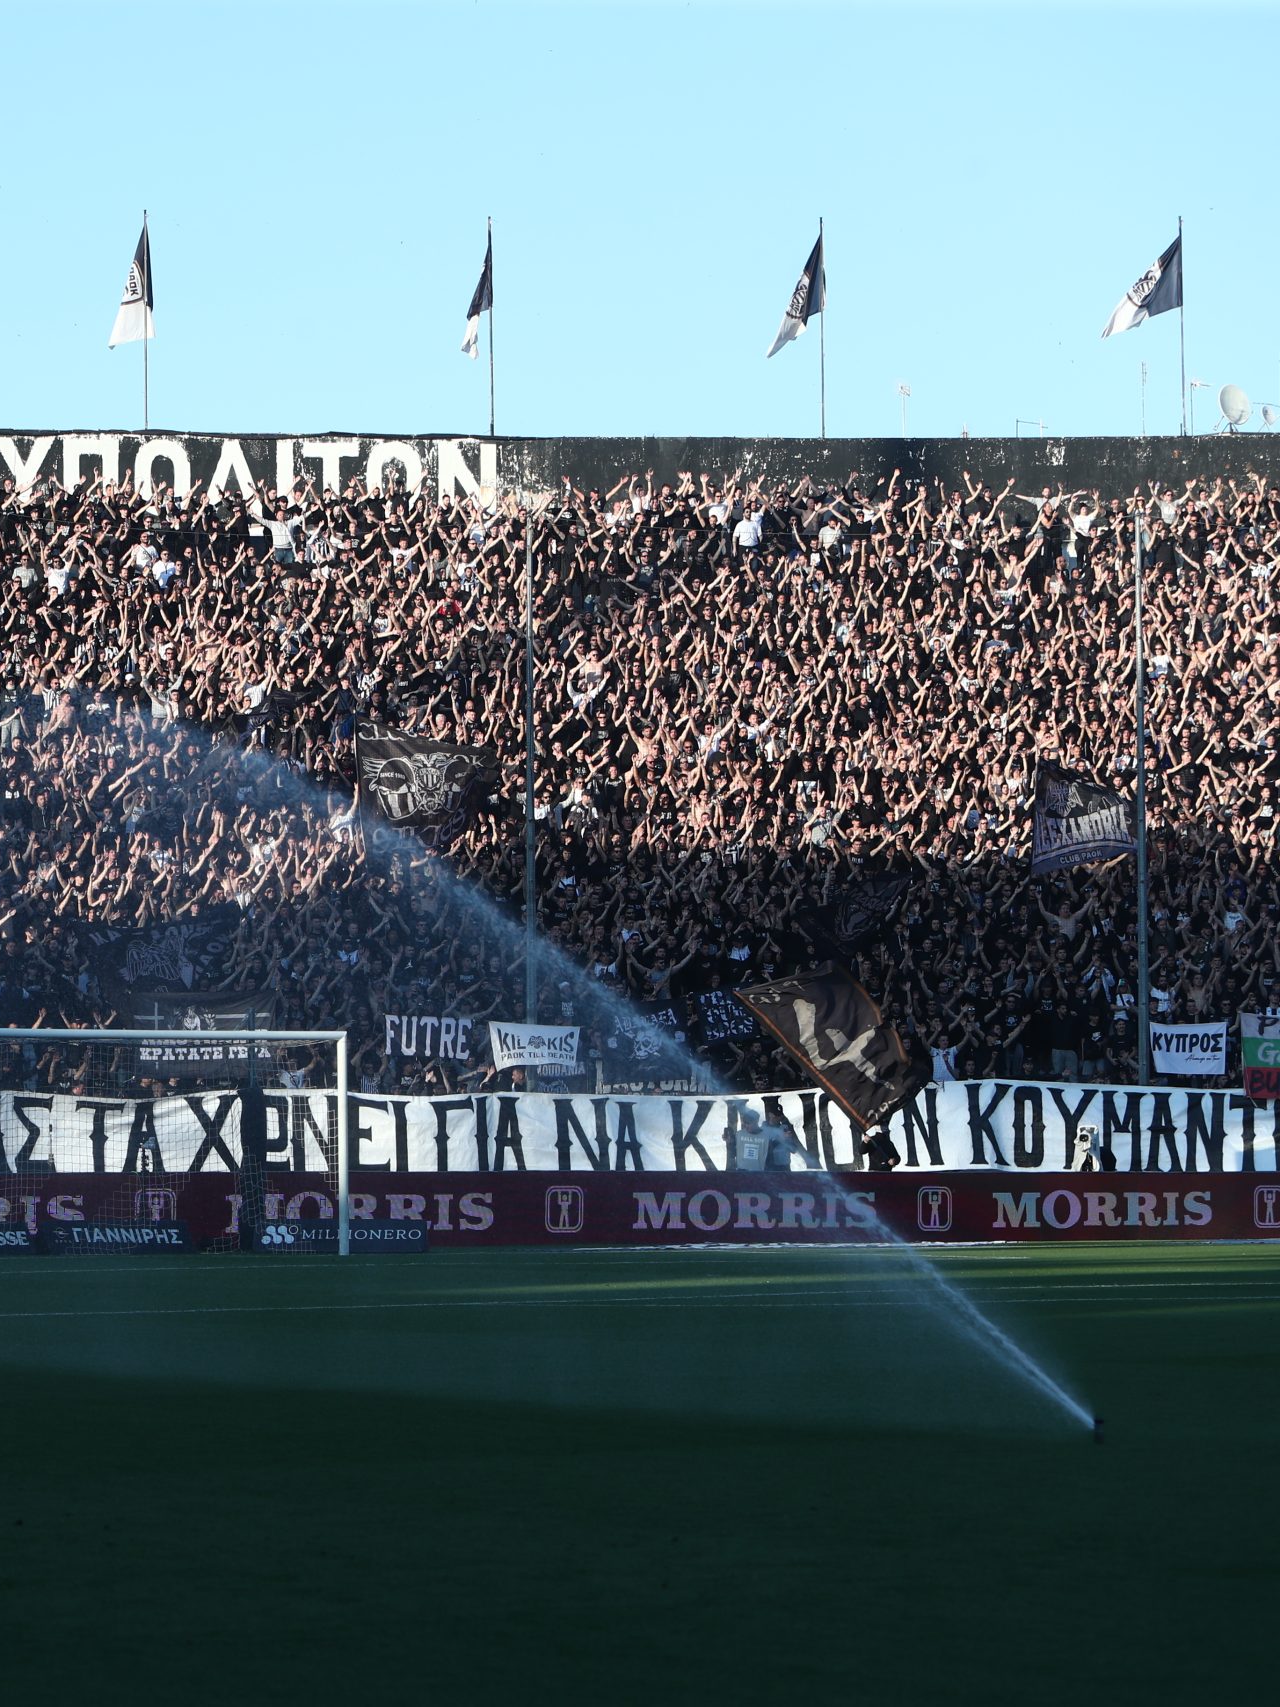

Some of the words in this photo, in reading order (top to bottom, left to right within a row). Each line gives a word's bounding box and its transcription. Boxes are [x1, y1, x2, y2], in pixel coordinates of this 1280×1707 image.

[1060, 855, 1080, 865] CLUB
[384, 1014, 473, 1060] FUTRE
[1152, 1031, 1224, 1053] ΚΥΠΡΟΣ
[139, 1047, 223, 1061] ΚΡΑΤΑΤΕ
[228, 1046, 271, 1059] ΓΕΑ
[501, 1052, 525, 1062] PAOK
[548, 1052, 575, 1062] DEATH
[431, 1096, 527, 1172] ΓΙΑ
[551, 1097, 646, 1172] ΝΑ
[964, 1082, 1280, 1172] ΚΟΥΜΑΝΤ
[632, 1189, 876, 1230] MORRIS
[992, 1189, 1213, 1229] MORRIS
[72, 1227, 183, 1245] ΓΙΑΝΝΙΡΗΣ
